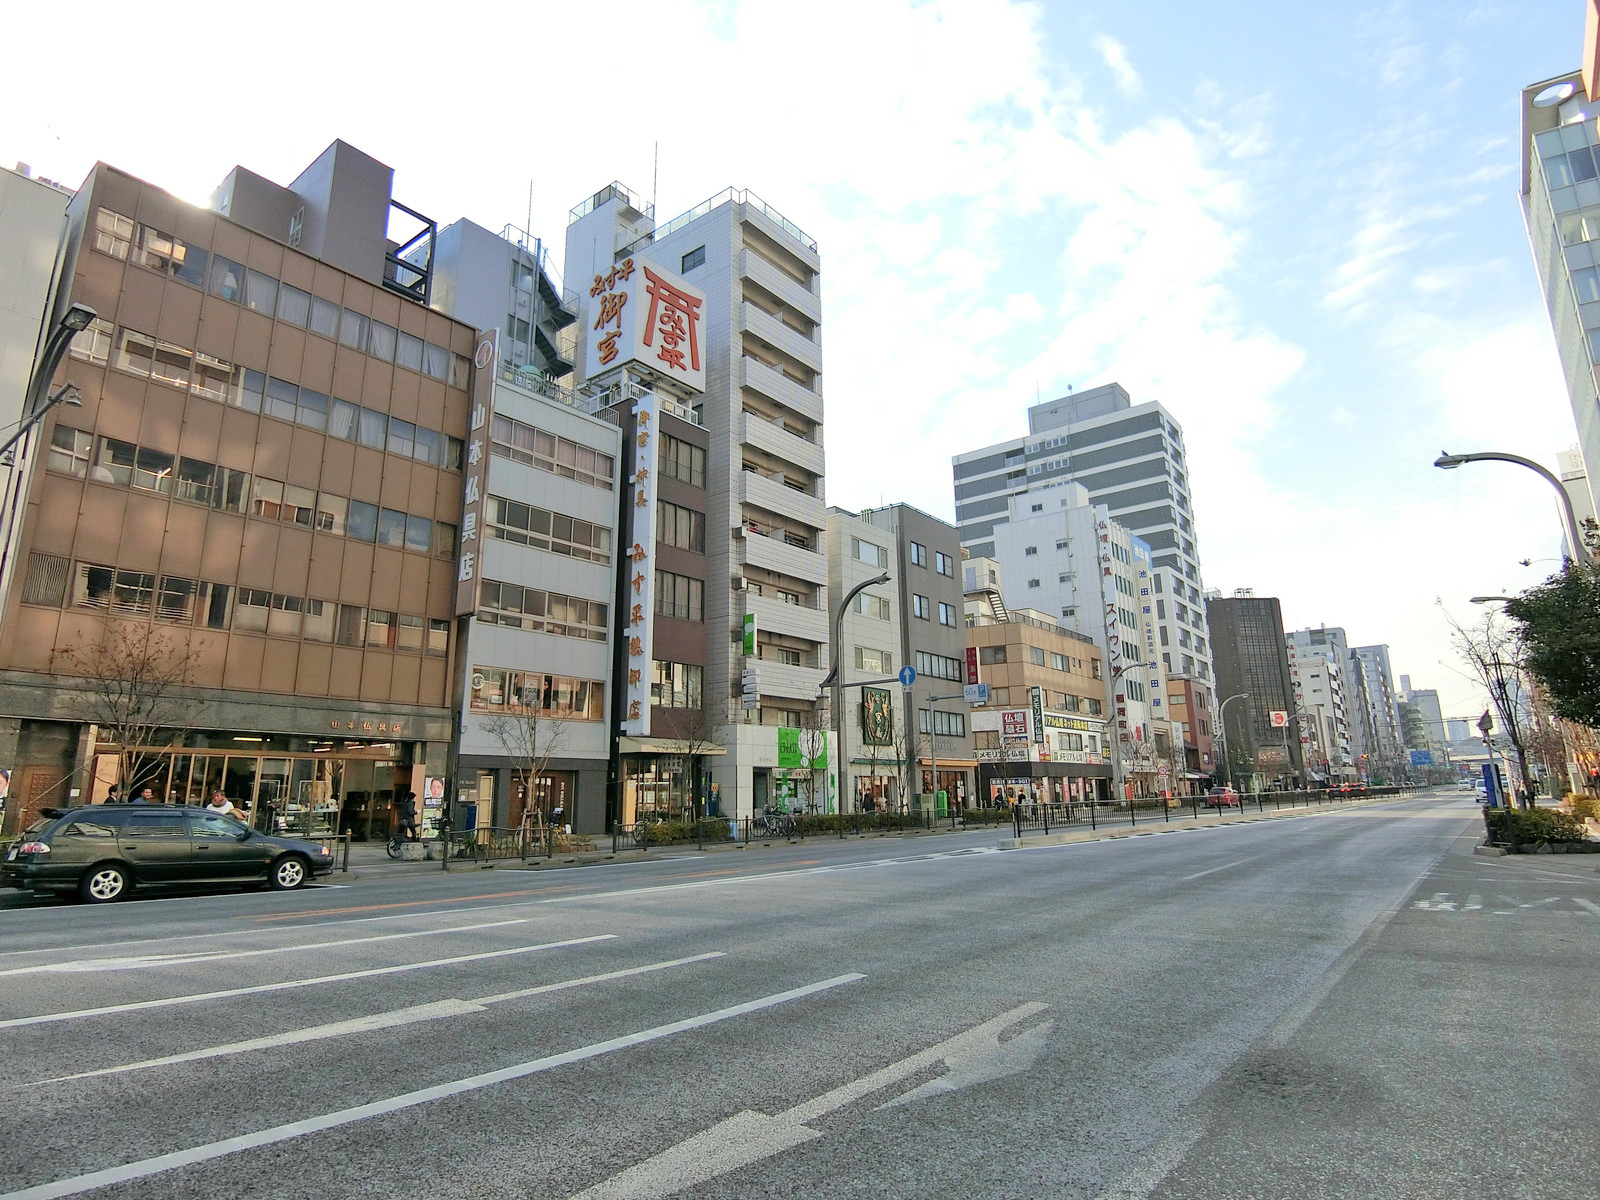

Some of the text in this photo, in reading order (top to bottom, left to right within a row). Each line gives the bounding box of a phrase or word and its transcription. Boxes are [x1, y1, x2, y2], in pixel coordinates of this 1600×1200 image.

[590, 257, 635, 297] みす平
[657, 304, 687, 371] みす平
[458, 403, 486, 582] 山本仏具店
[1099, 521, 1112, 577] 仏壇・仏具
[1138, 569, 1151, 615] 池田屋
[1149, 661, 1161, 707] 池田屋
[331, 720, 402, 733] 山本仏具店
[1005, 713, 1024, 723] 仏壇
